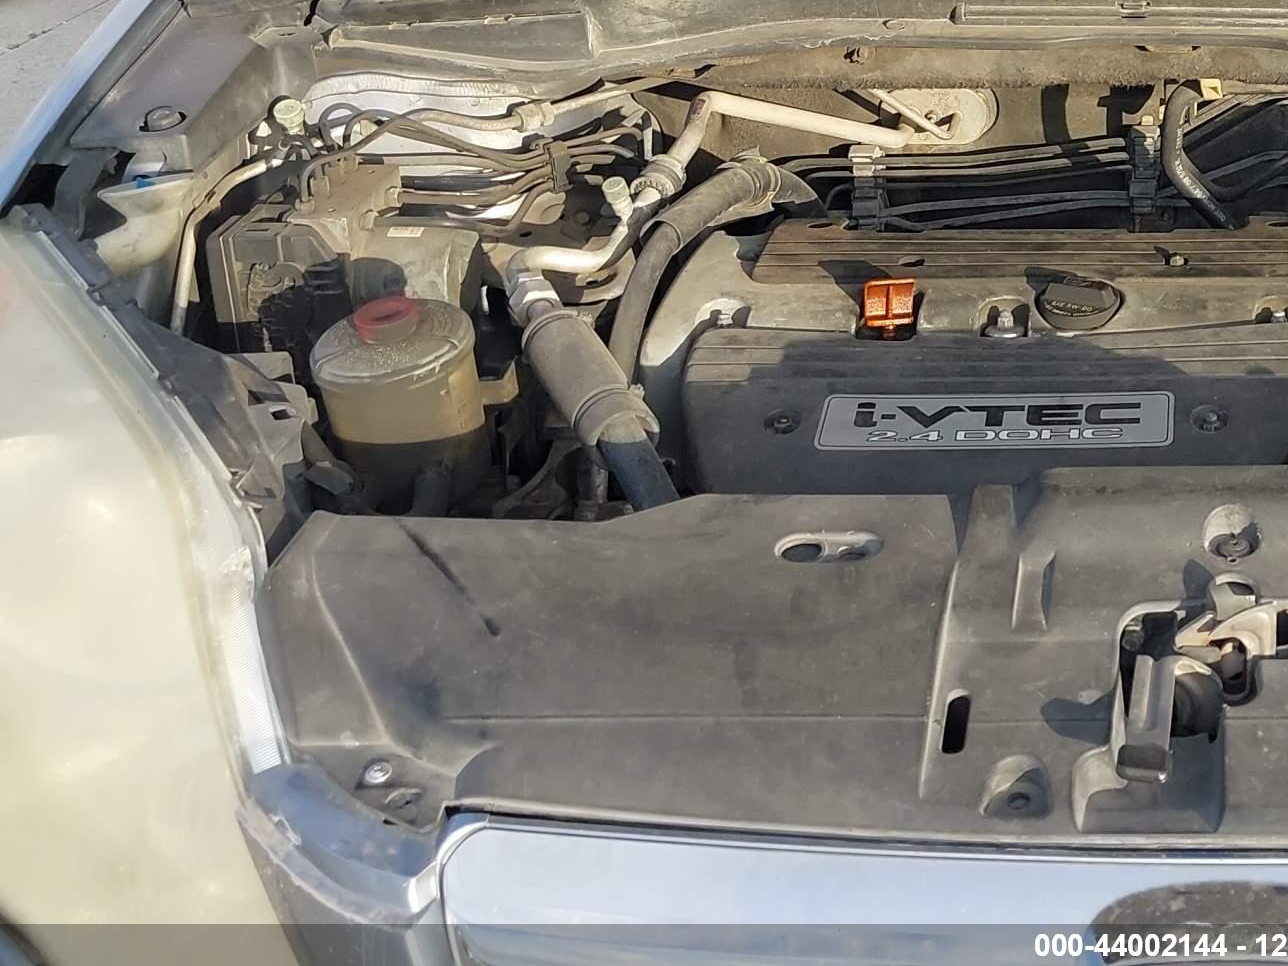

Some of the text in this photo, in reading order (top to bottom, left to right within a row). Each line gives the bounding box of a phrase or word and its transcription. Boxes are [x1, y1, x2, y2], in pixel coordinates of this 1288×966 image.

[853, 401, 1142, 429] i-VTEC
[866, 427, 1124, 443] 2.4 DOHC
